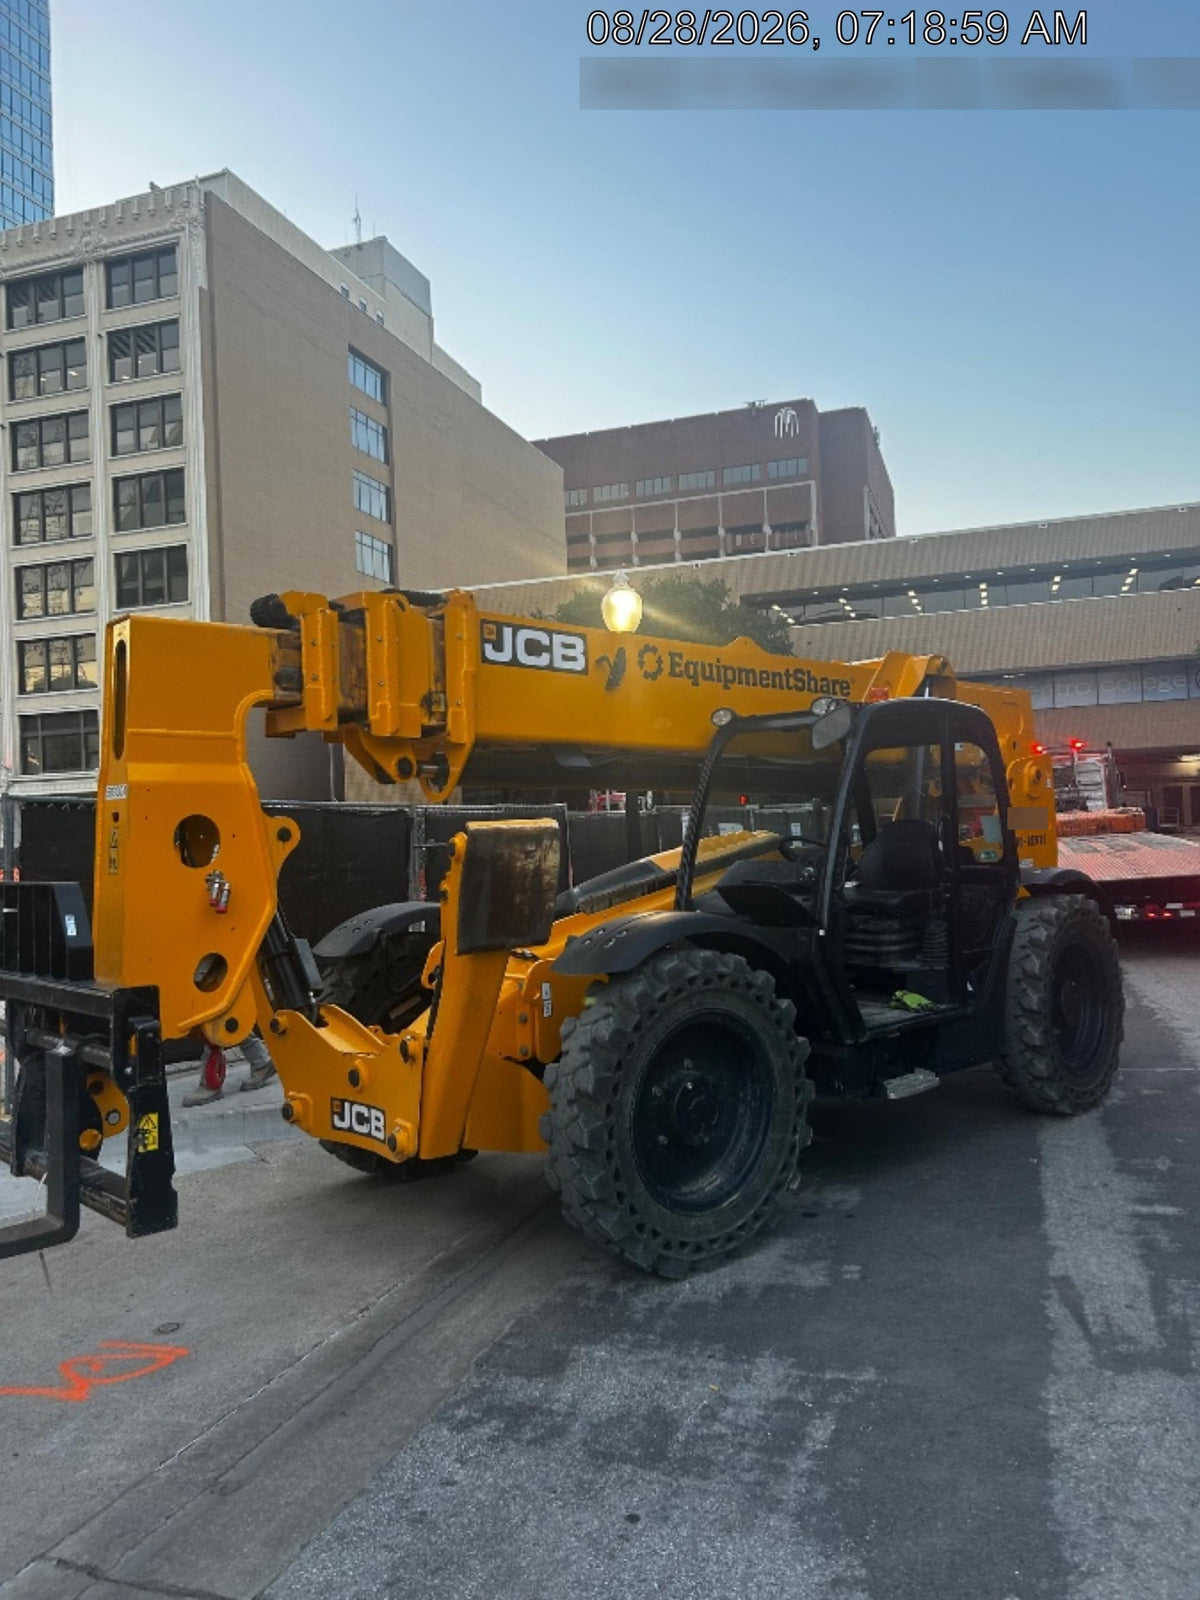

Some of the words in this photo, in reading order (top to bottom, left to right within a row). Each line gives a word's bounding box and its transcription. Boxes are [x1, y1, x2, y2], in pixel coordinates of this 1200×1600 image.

[484, 626, 586, 671] JCB
[668, 652, 851, 697] EquipmentShare
[333, 1101, 385, 1141] JCB
